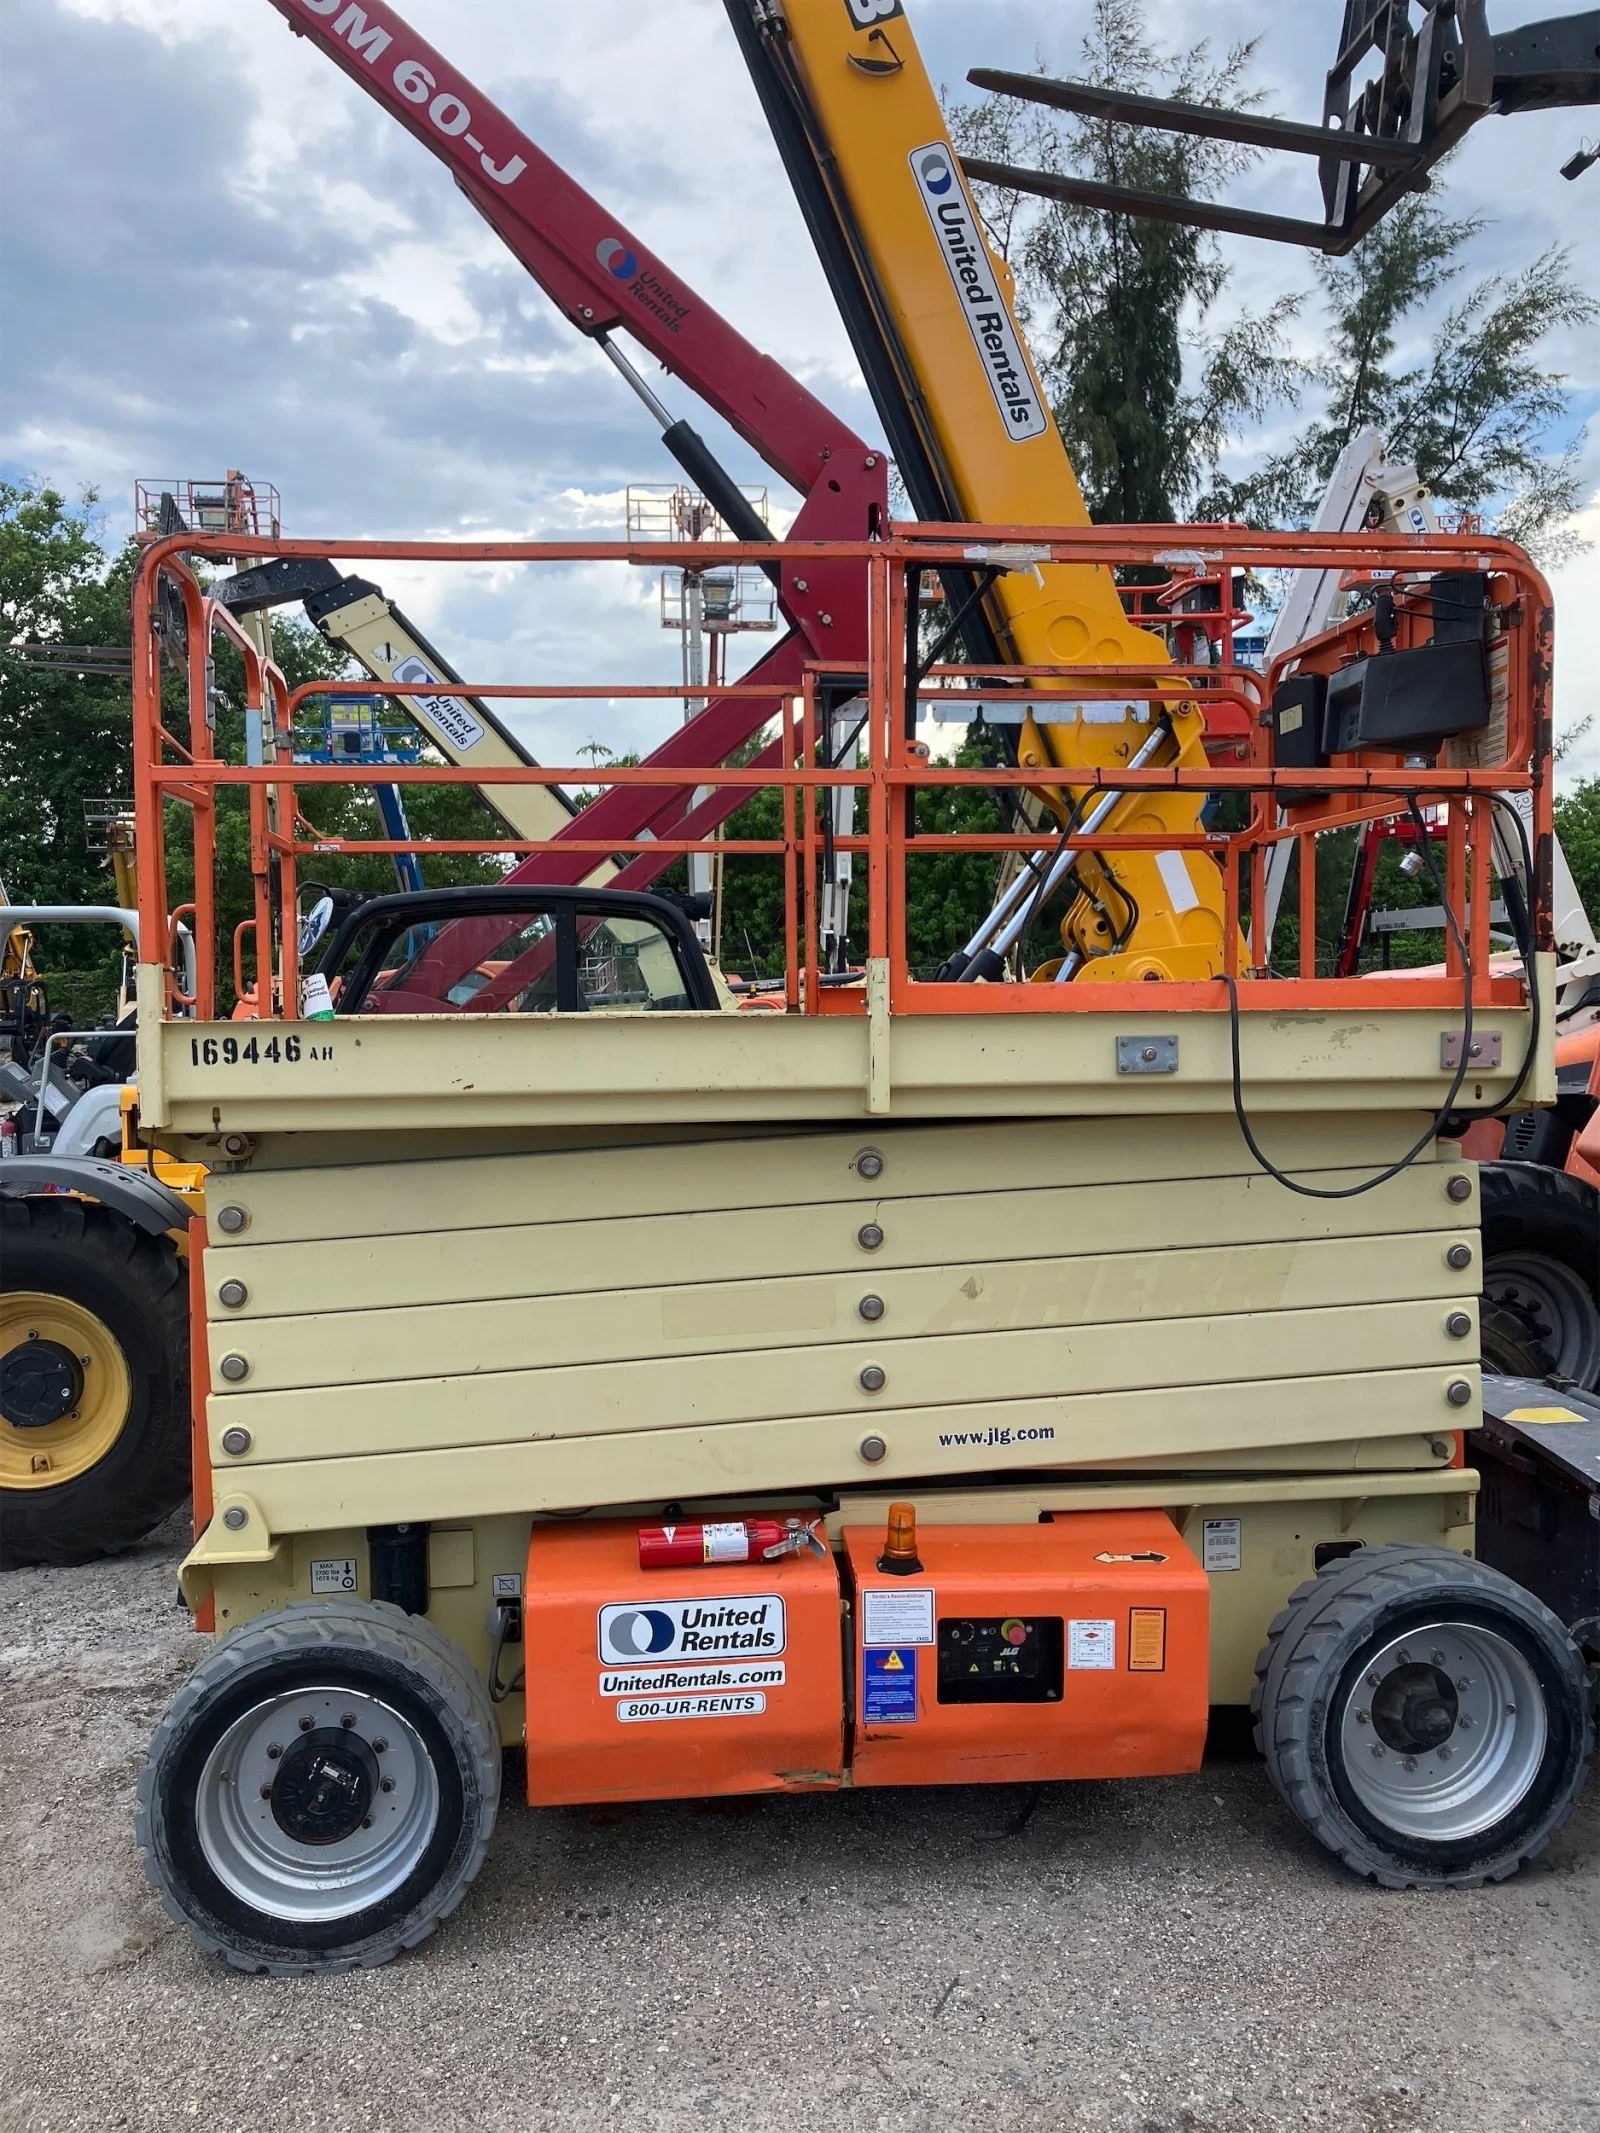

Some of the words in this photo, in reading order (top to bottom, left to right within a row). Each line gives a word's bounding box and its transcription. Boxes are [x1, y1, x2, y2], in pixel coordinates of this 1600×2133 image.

[393, 60, 528, 185] 60-J
[628, 281, 682, 333] Rentals
[638, 269, 691, 318] United
[937, 202, 994, 304] United
[975, 312, 1030, 424] Rentals
[426, 701, 468, 745] Rentals
[436, 695, 477, 734] United
[191, 1035, 301, 1066] 169446
[310, 1047, 333, 1060] AH
[939, 1427, 1055, 1446] www.jlg.com
[681, 1605, 768, 1629] United
[680, 1628, 775, 1651] Rentals
[1000, 1647, 1020, 1656] JLG
[603, 1669, 783, 1692] UnitedRentals.com
[628, 1696, 756, 1717] 800-UR-RENTS
